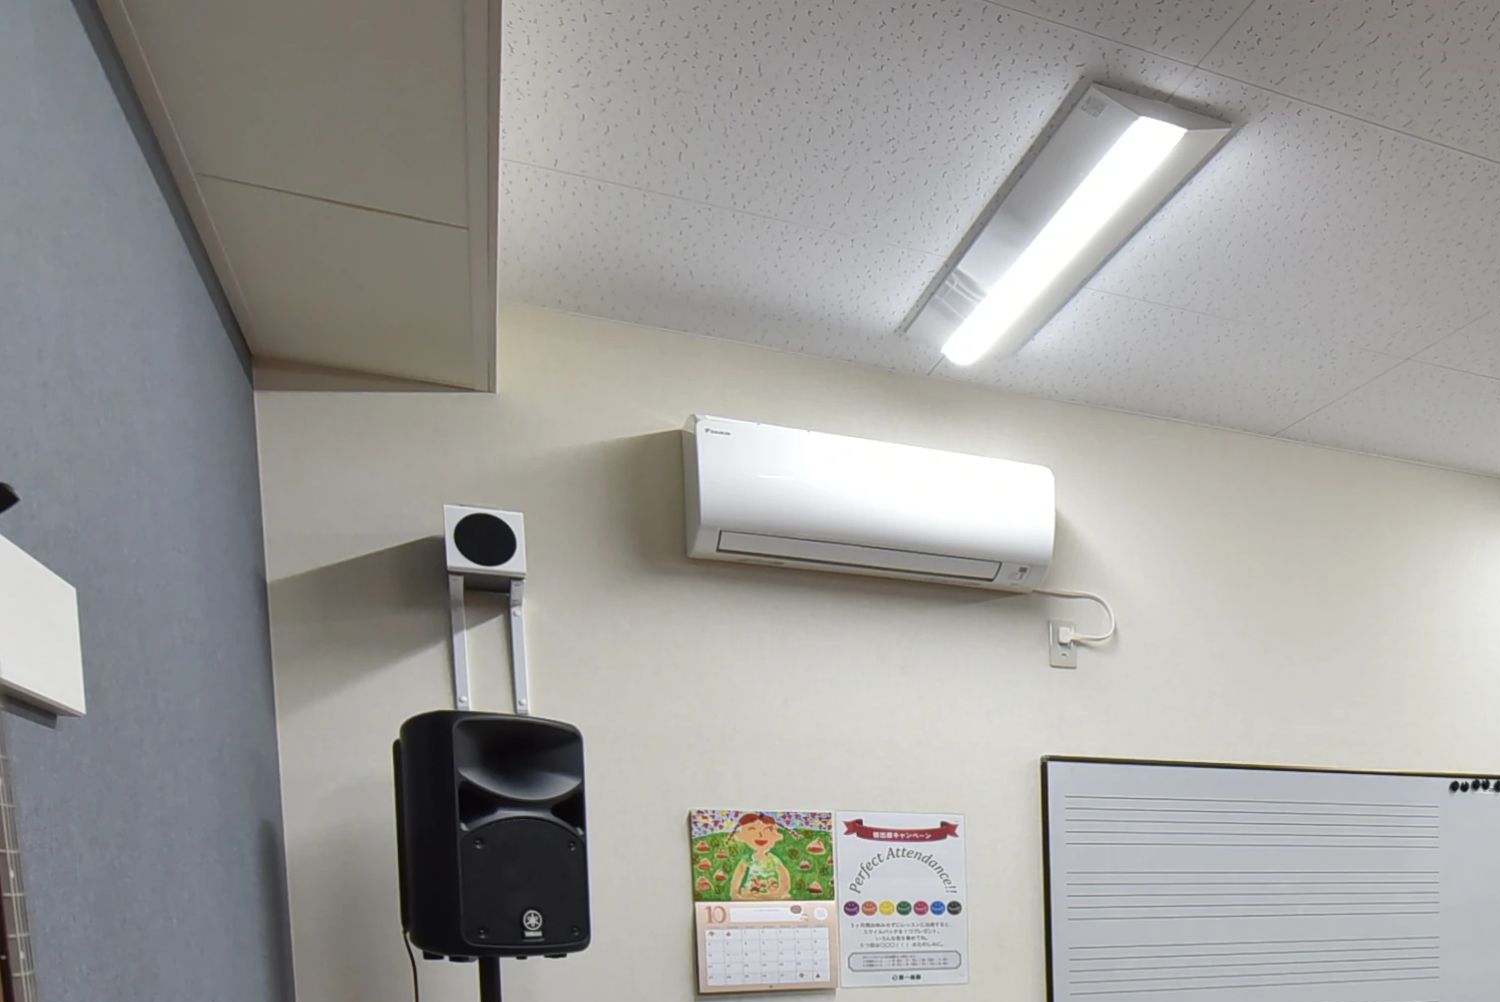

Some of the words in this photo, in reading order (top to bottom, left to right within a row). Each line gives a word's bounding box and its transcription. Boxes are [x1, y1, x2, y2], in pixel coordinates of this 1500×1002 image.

[849, 853, 885, 894] Perfect
[886, 847, 958, 894] Attendance!!
[705, 905, 727, 924] 10
